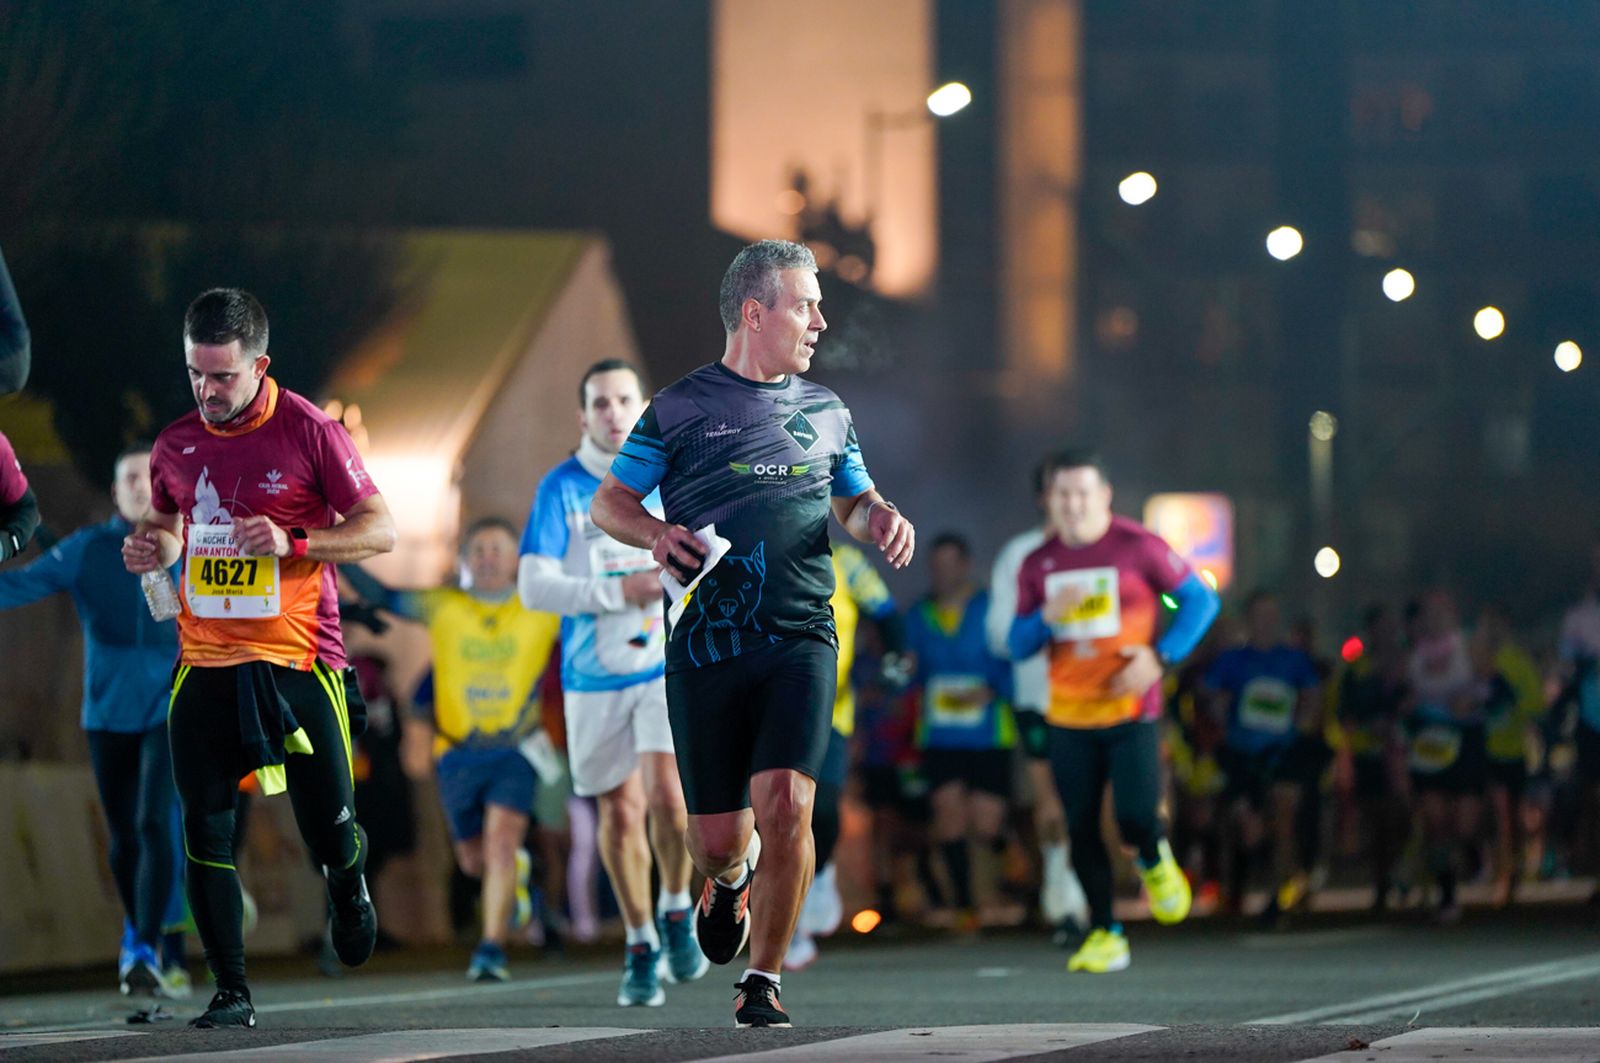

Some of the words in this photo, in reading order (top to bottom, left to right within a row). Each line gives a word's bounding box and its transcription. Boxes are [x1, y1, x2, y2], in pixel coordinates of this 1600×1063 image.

[753, 464, 788, 476] OCR
[202, 535, 227, 545] NOCHE
[194, 546, 209, 556] SAN
[201, 559, 258, 586] 4627
